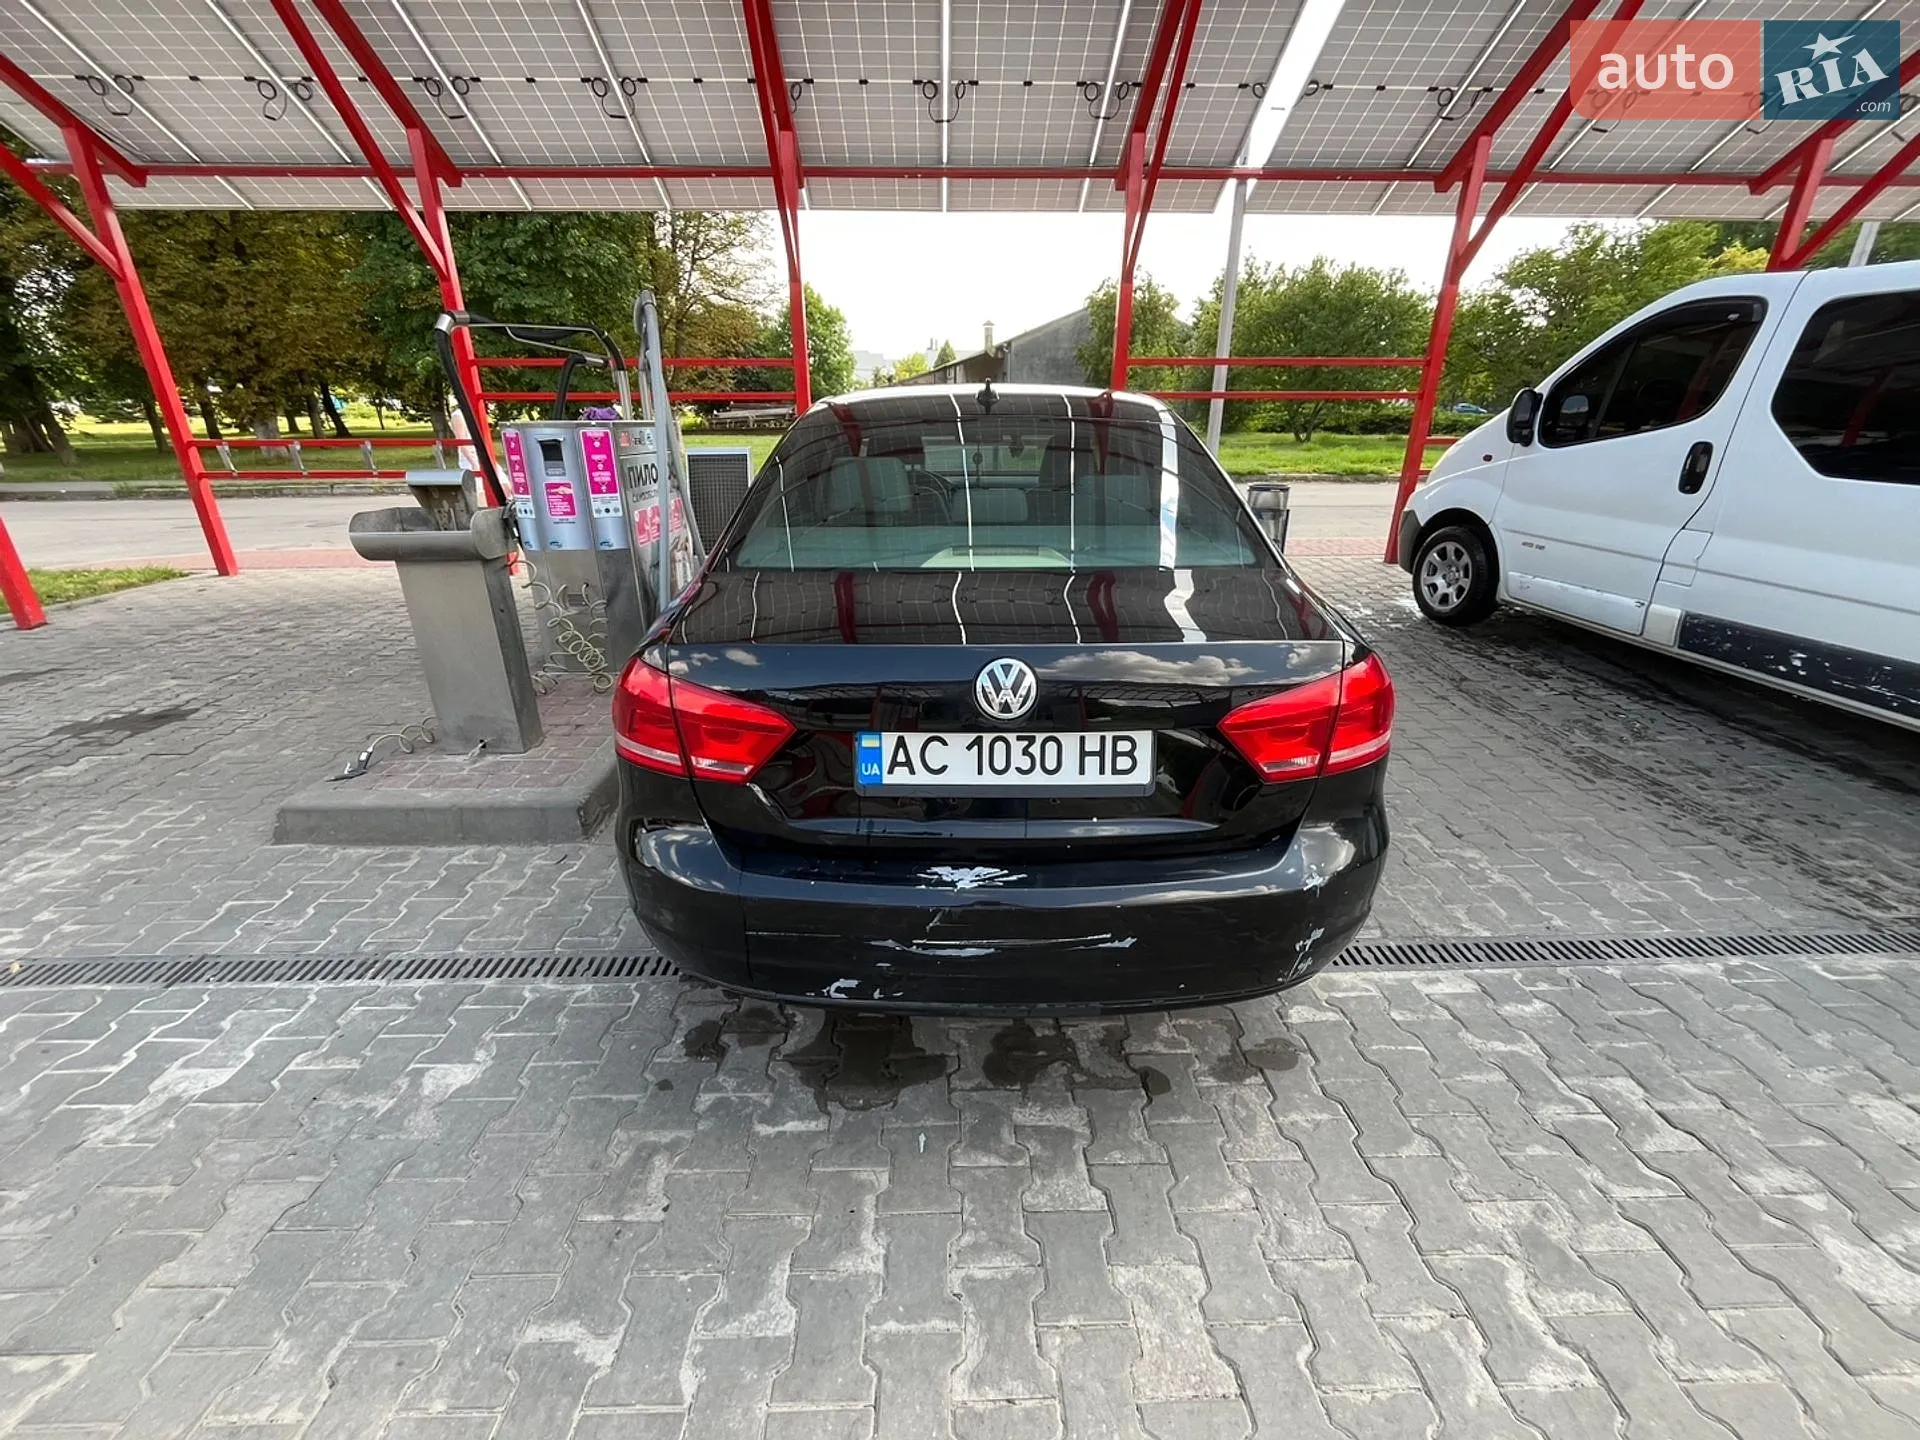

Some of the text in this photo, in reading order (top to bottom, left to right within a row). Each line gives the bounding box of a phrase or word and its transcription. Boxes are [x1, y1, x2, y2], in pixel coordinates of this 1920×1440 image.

[886, 734, 1138, 776] AC 1030 HB
[861, 764, 881, 777] UA
